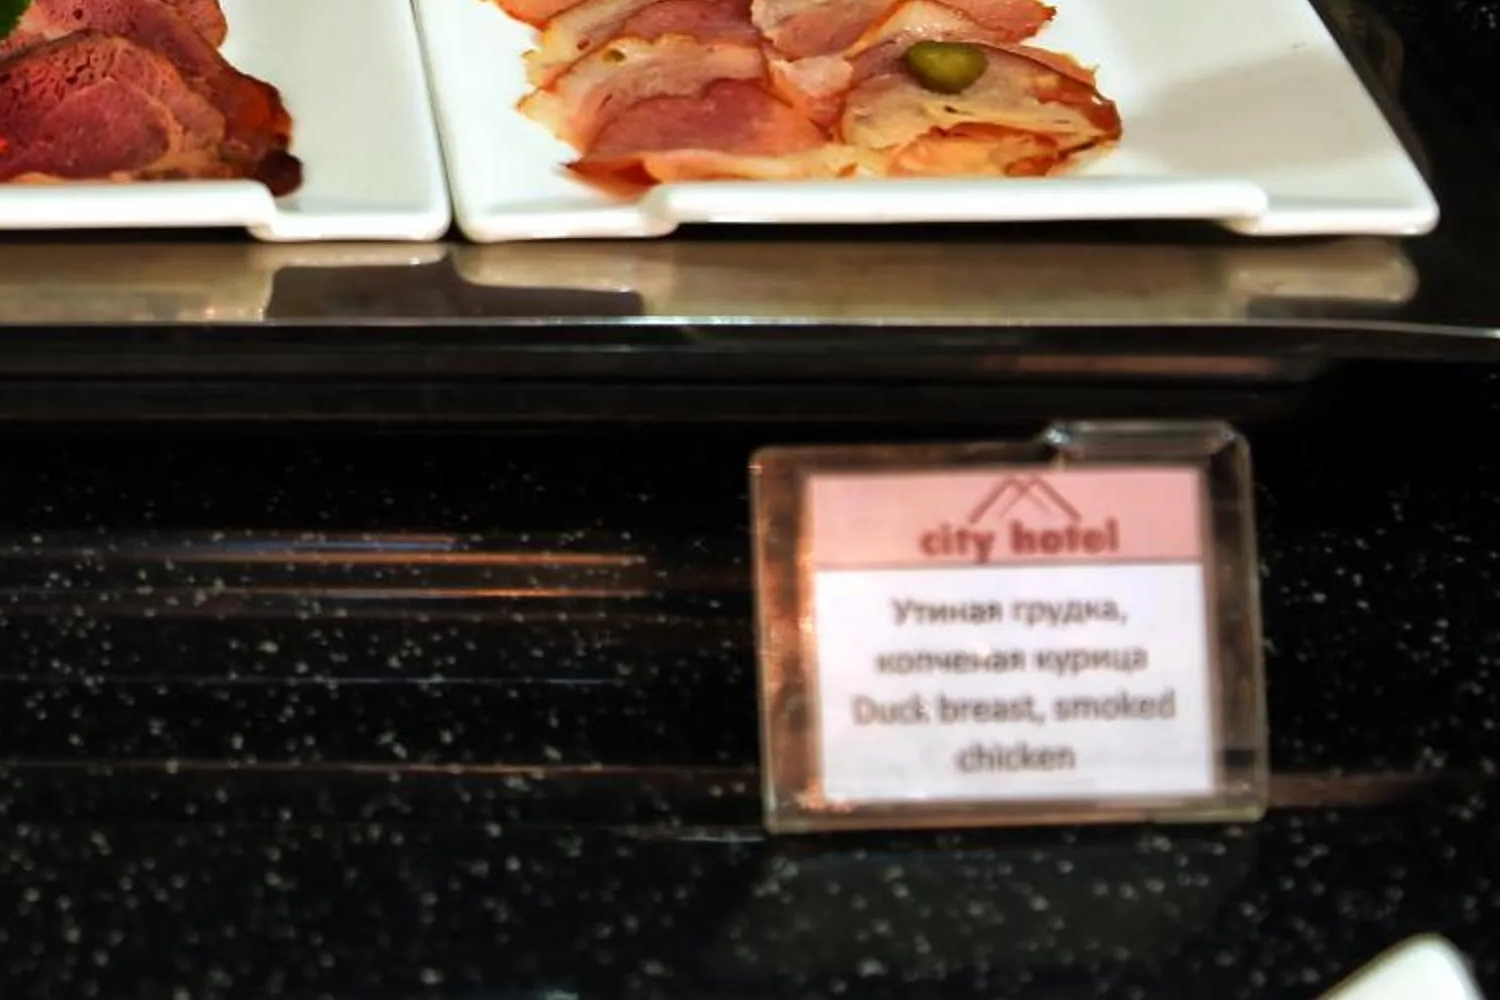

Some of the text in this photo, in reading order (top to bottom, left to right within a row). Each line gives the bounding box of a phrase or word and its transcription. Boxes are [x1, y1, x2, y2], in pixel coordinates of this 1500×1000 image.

[920, 518, 1119, 562] city hotel
[890, 597, 1127, 628] Утиная грудка,
[876, 647, 1149, 676] копченая курица
[853, 690, 1177, 726] Duck breast, smoked
[956, 742, 1077, 774] chicken
